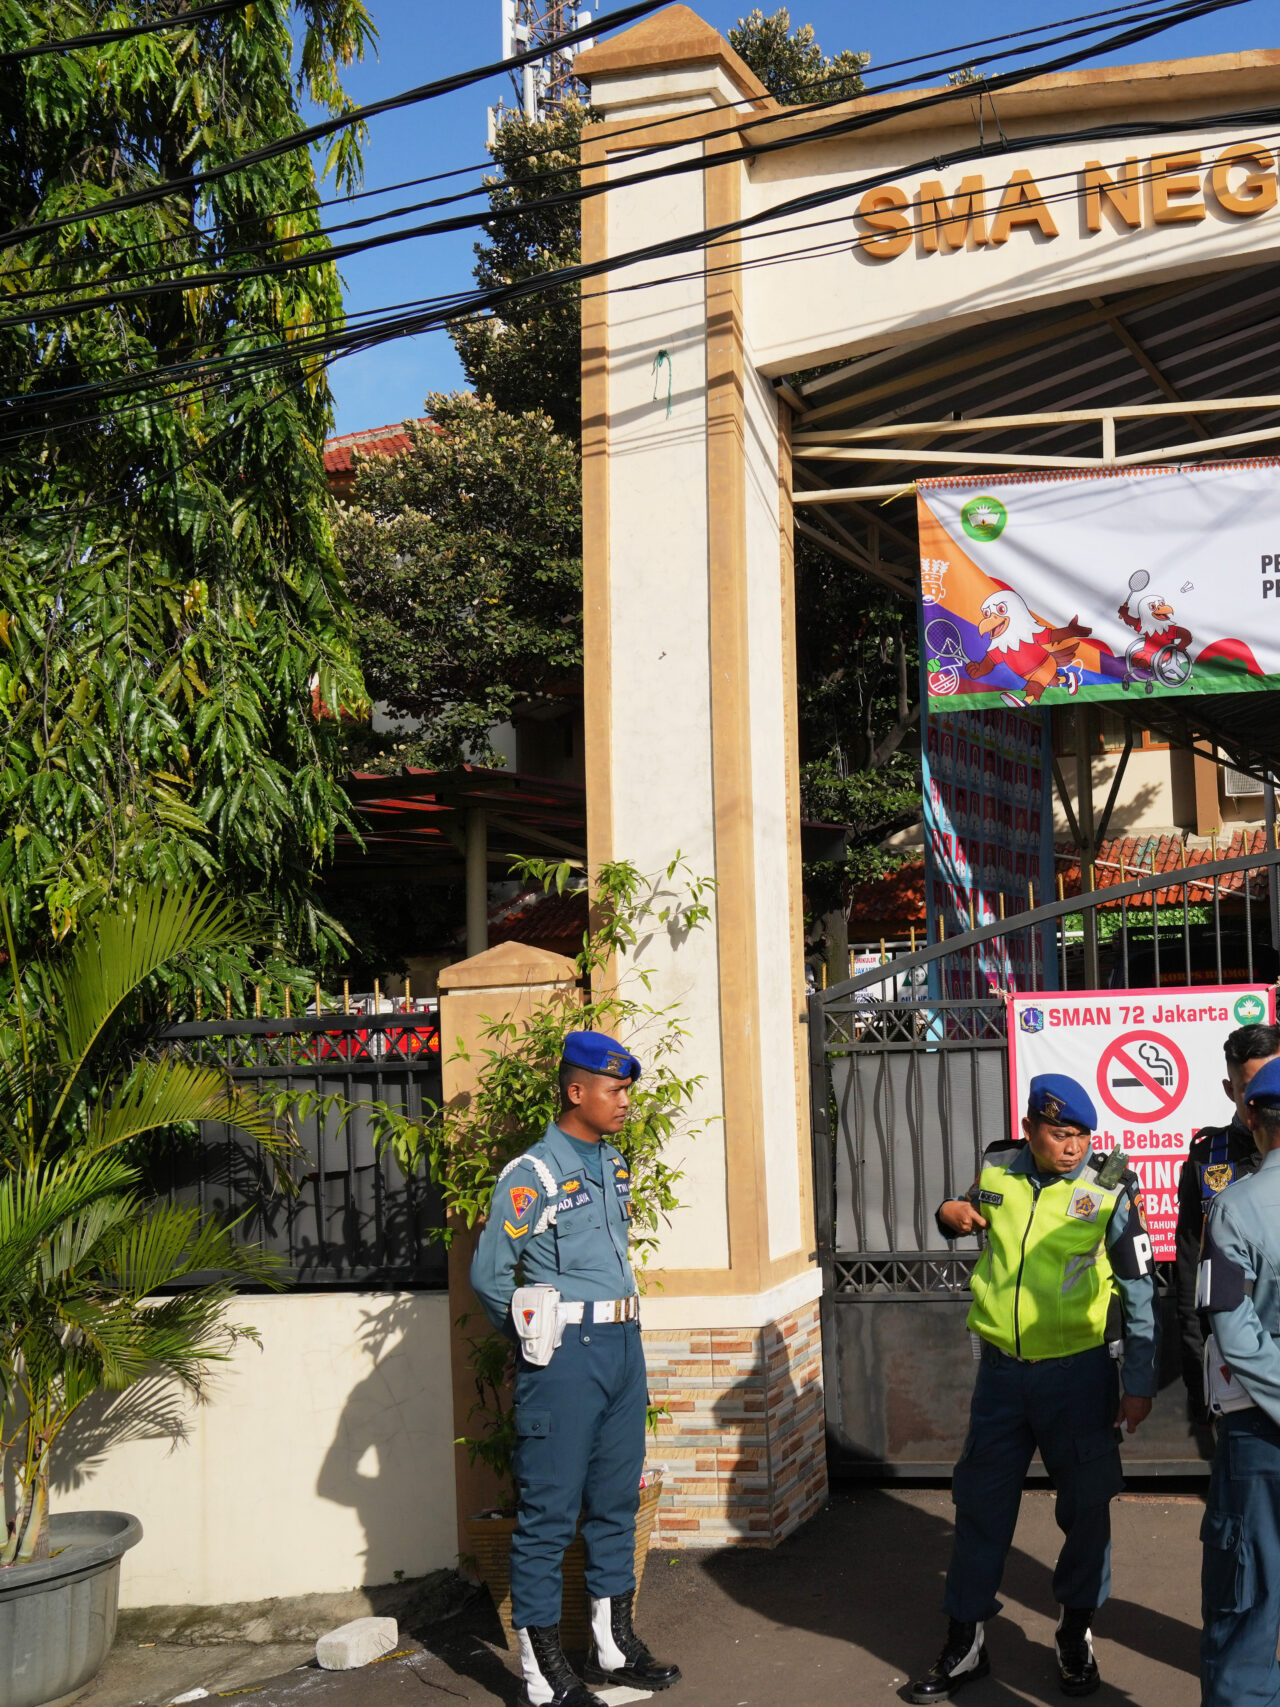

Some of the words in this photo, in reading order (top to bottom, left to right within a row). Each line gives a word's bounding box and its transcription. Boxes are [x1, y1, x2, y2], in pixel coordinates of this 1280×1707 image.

[859, 168, 1059, 259] SMA
[1049, 1006, 1111, 1027] SMAN
[1119, 1005, 1145, 1025] 72
[1152, 1004, 1228, 1024] Jakarta
[1123, 1129, 1184, 1150] Bebas
[1150, 1234, 1165, 1243] gan
